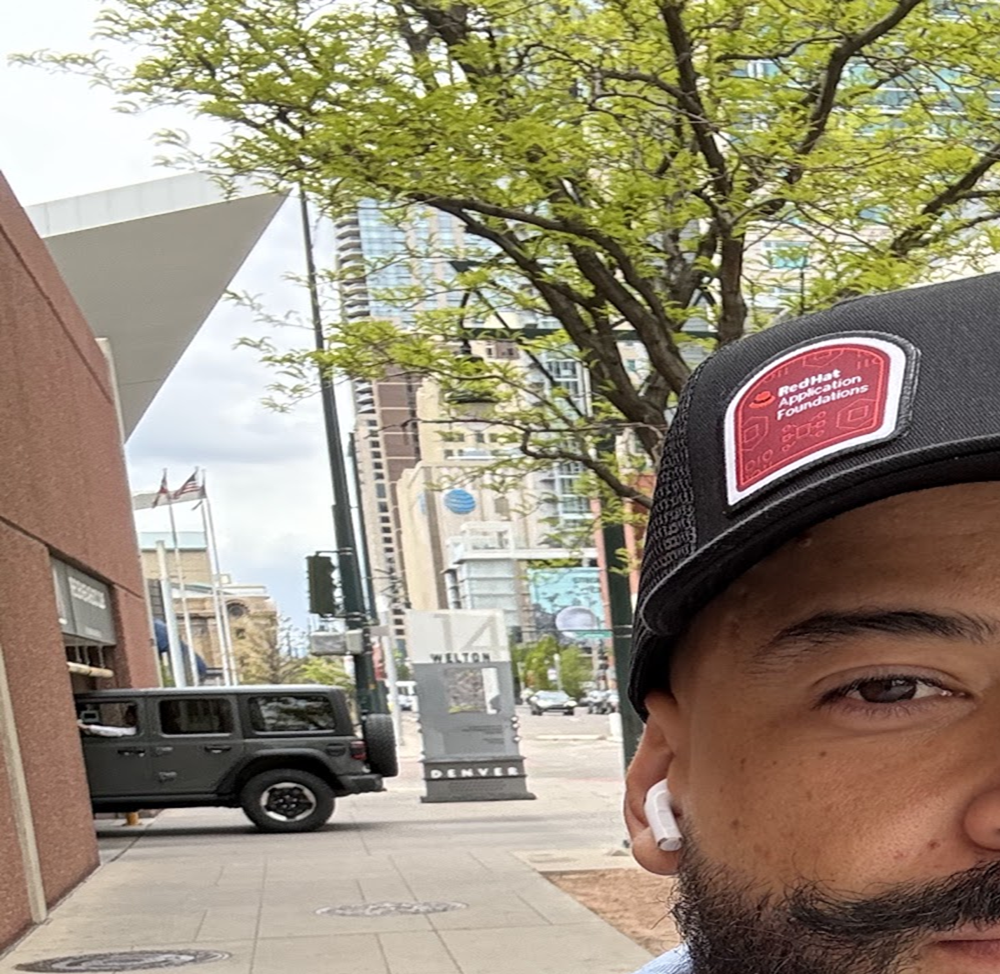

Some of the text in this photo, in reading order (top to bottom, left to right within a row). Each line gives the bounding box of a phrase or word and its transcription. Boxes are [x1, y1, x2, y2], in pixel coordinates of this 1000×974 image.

[776, 384, 869, 421] Foundations
[778, 376, 862, 408] Application
[433, 613, 507, 660] 14
[430, 652, 491, 664] WELTON
[430, 767, 519, 779] DENVER
